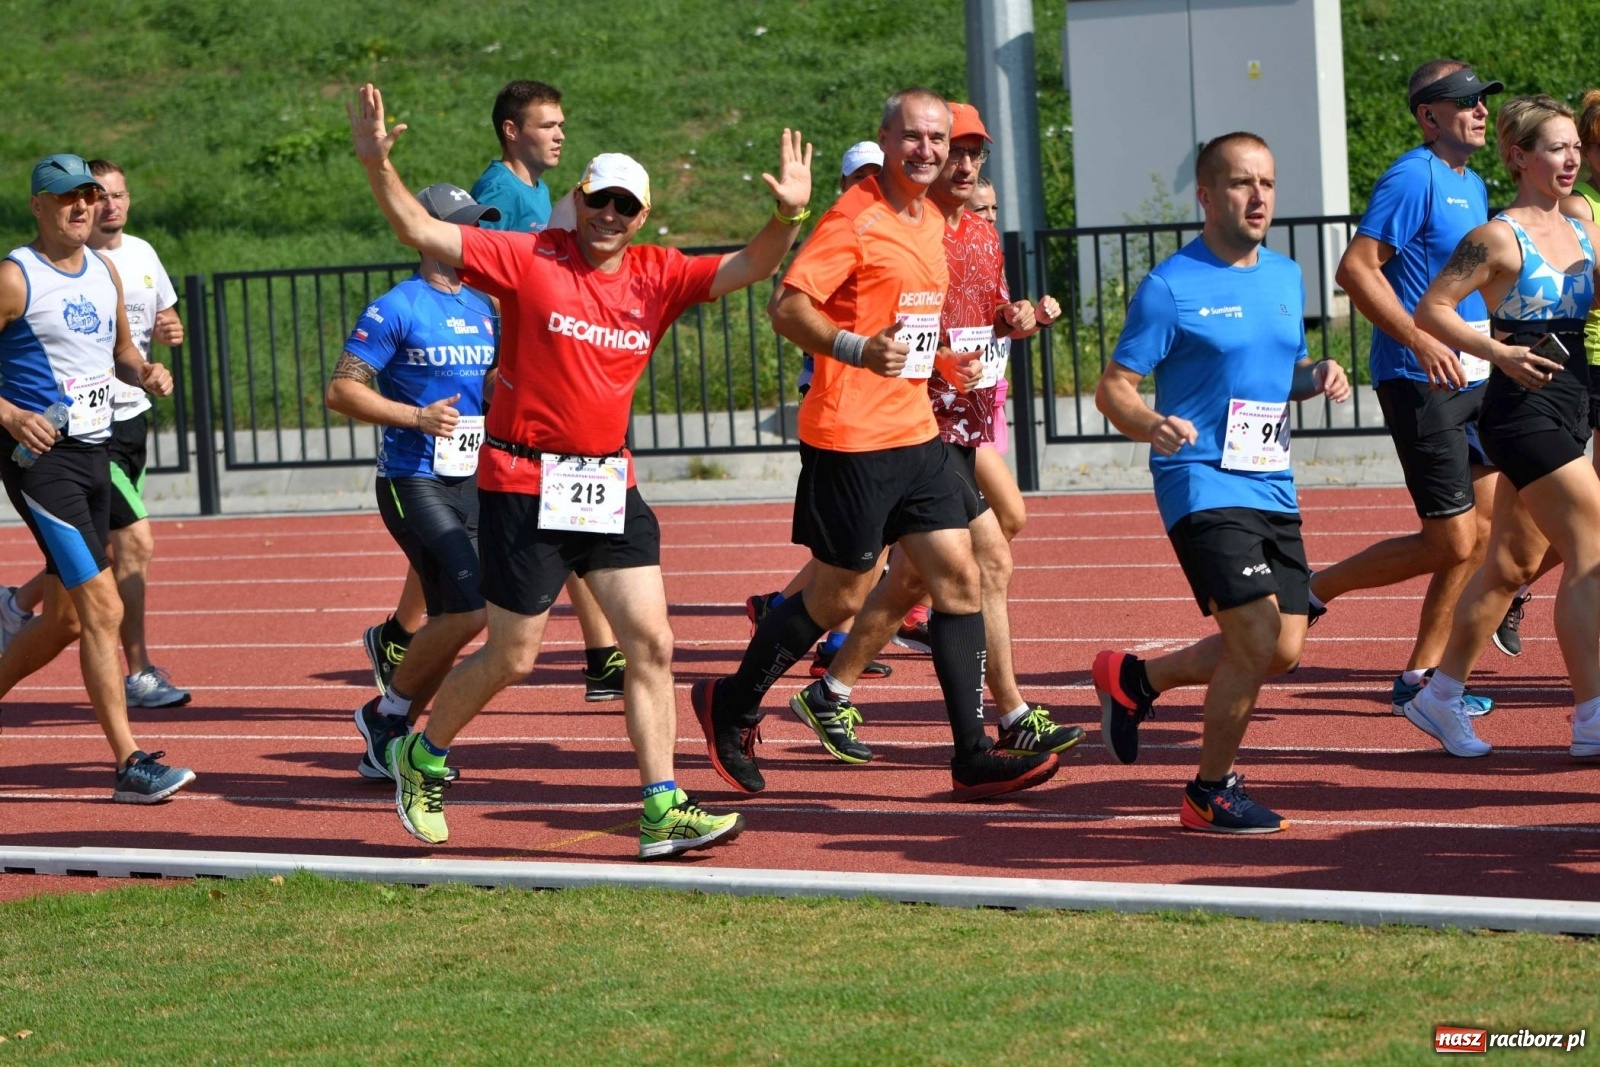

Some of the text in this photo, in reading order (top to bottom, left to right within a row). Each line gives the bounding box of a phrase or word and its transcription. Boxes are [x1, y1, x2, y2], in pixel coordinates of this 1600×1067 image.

[548, 311, 651, 350] DECATHLON
[406, 345, 494, 366] RUNNE
[570, 482, 606, 505] 213
